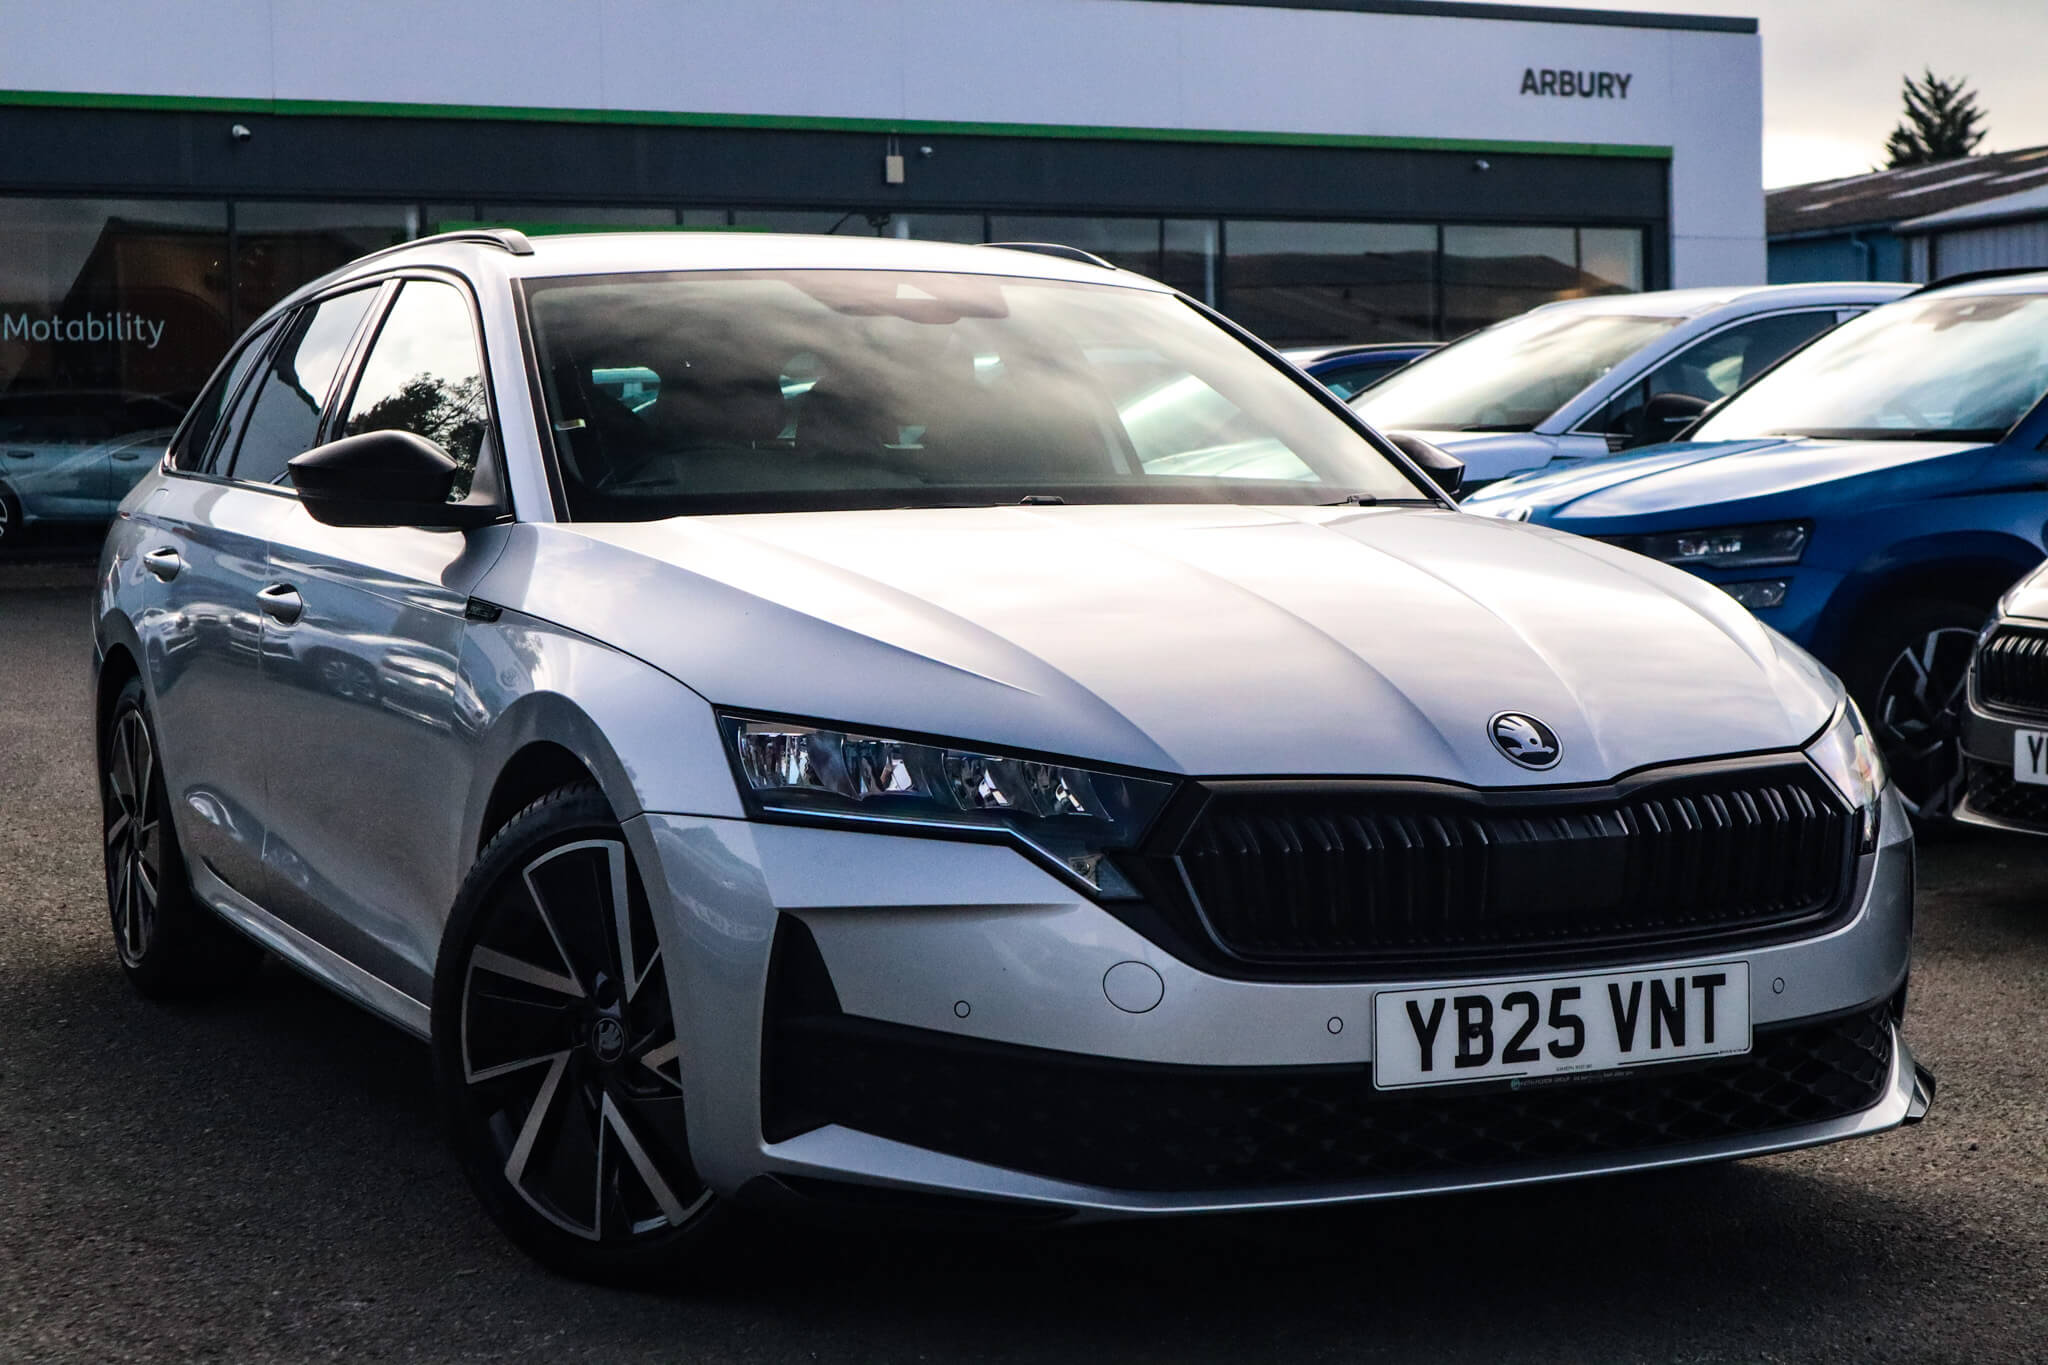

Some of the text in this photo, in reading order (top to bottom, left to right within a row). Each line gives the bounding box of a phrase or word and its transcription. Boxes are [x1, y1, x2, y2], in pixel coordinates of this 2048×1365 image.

[1520, 67, 1633, 99] ARBURY
[3, 312, 165, 349] Motability
[2027, 735, 2048, 775] Y
[1406, 973, 1726, 1072] YB25 VNT
